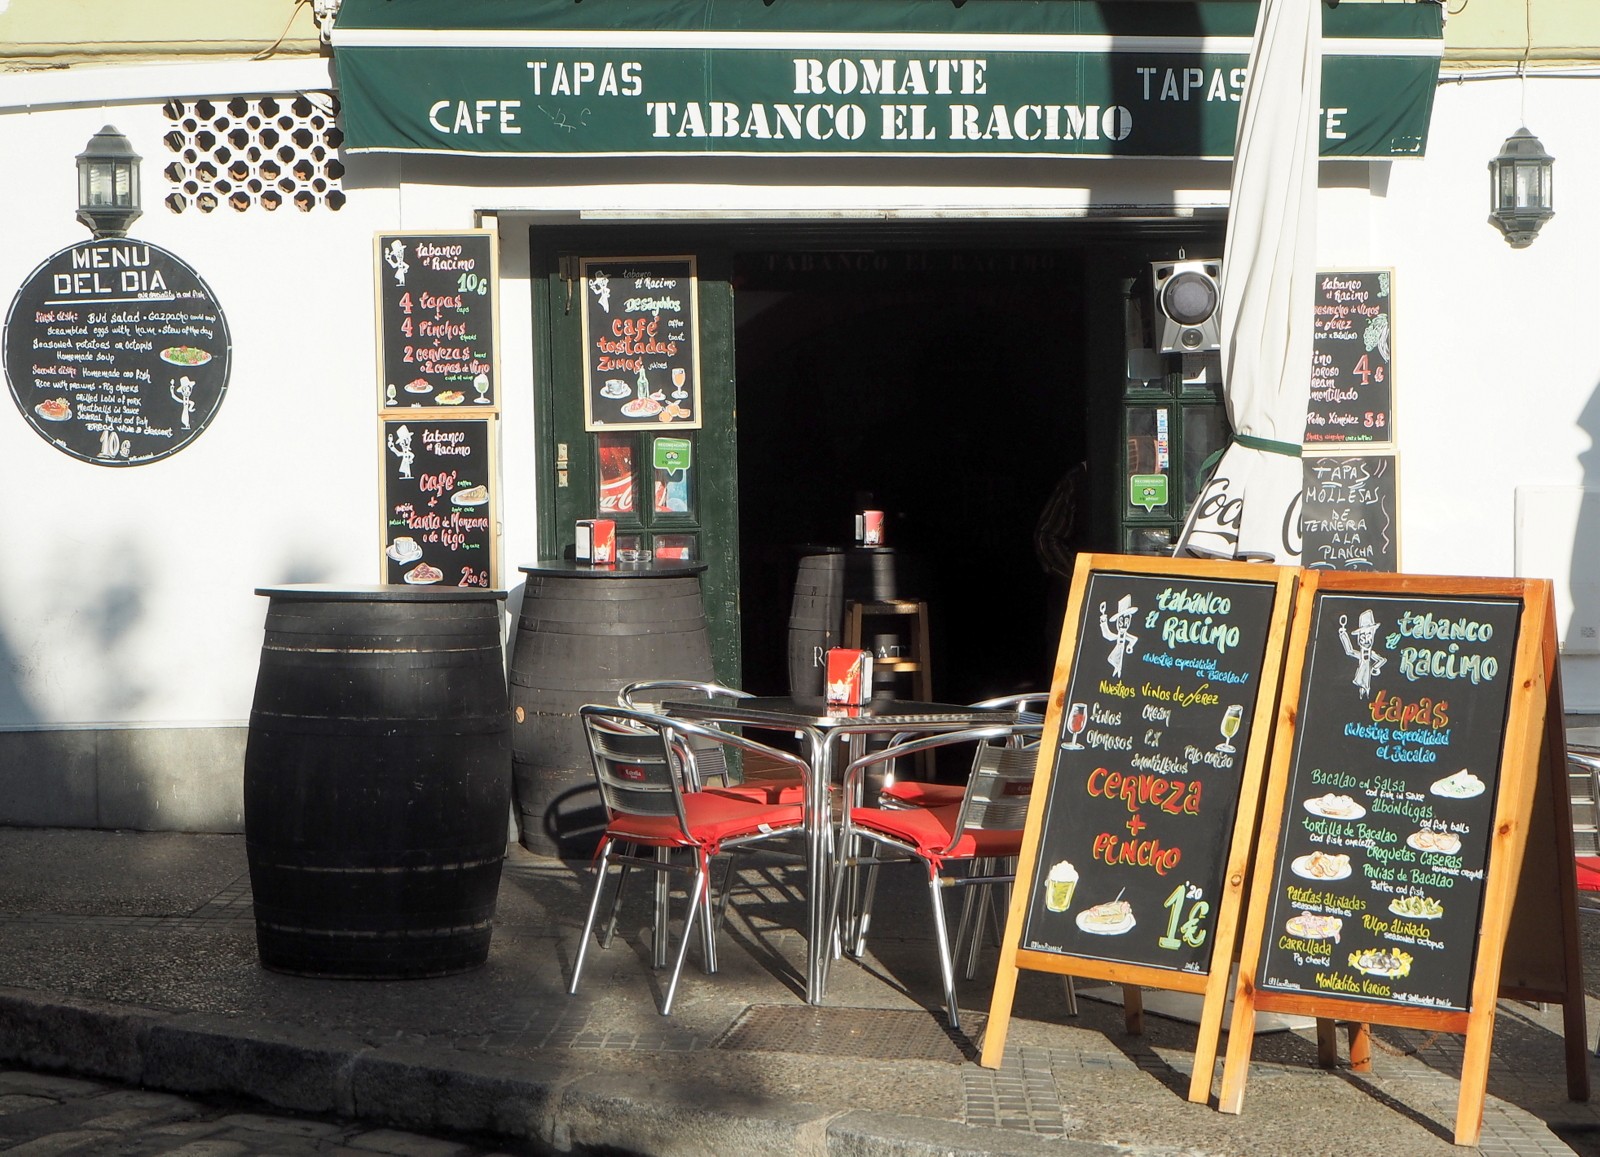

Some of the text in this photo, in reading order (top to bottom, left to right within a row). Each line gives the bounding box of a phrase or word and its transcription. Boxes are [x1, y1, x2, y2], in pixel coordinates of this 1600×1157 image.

[526, 61, 642, 97] TAPAS
[793, 58, 987, 95] ROMATE
[429, 100, 521, 135] CAFE
[647, 102, 1134, 141] TABANCO EL RACIMO
[72, 246, 150, 269] MENU
[415, 243, 462, 258] tabanco
[432, 256, 475, 271] Racimo
[54, 270, 167, 294] DEL DIA
[1322, 276, 1362, 291] tabanco
[399, 291, 462, 314] 4 tapas
[401, 316, 466, 340] 4 Pinchos
[403, 345, 414, 362] 2
[596, 335, 678, 357] tostadas
[1312, 350, 1332, 366] ino
[1353, 354, 1371, 386] 4
[1309, 387, 1359, 403] montillado
[422, 429, 465, 444] tabanco
[434, 442, 471, 456] Racimo
[1312, 462, 1371, 483] TAPAS
[1304, 518, 1368, 532] TERNERA
[1332, 509, 1350, 521] DE
[441, 529, 465, 551] higo
[1318, 544, 1374, 560] PLANCHA
[1156, 587, 1231, 615] tabanco
[1162, 616, 1240, 654] Racimo
[1397, 610, 1493, 642] tabanco
[1399, 642, 1498, 685] Racimo
[1099, 680, 1136, 698] Nuestros
[1141, 681, 1171, 701] Vinos
[1172, 685, 1184, 702] de
[1368, 689, 1450, 731] tapas
[1310, 768, 1357, 788] Bacalao
[1373, 775, 1406, 792] Salsa
[1087, 767, 1203, 816] Cerveza
[1125, 813, 1147, 836] +
[1343, 822, 1355, 837] de
[1356, 823, 1398, 843] Bacalao
[1396, 868, 1408, 882] de
[1410, 868, 1454, 888] Bacalao
[1287, 885, 1323, 904] Patatas
